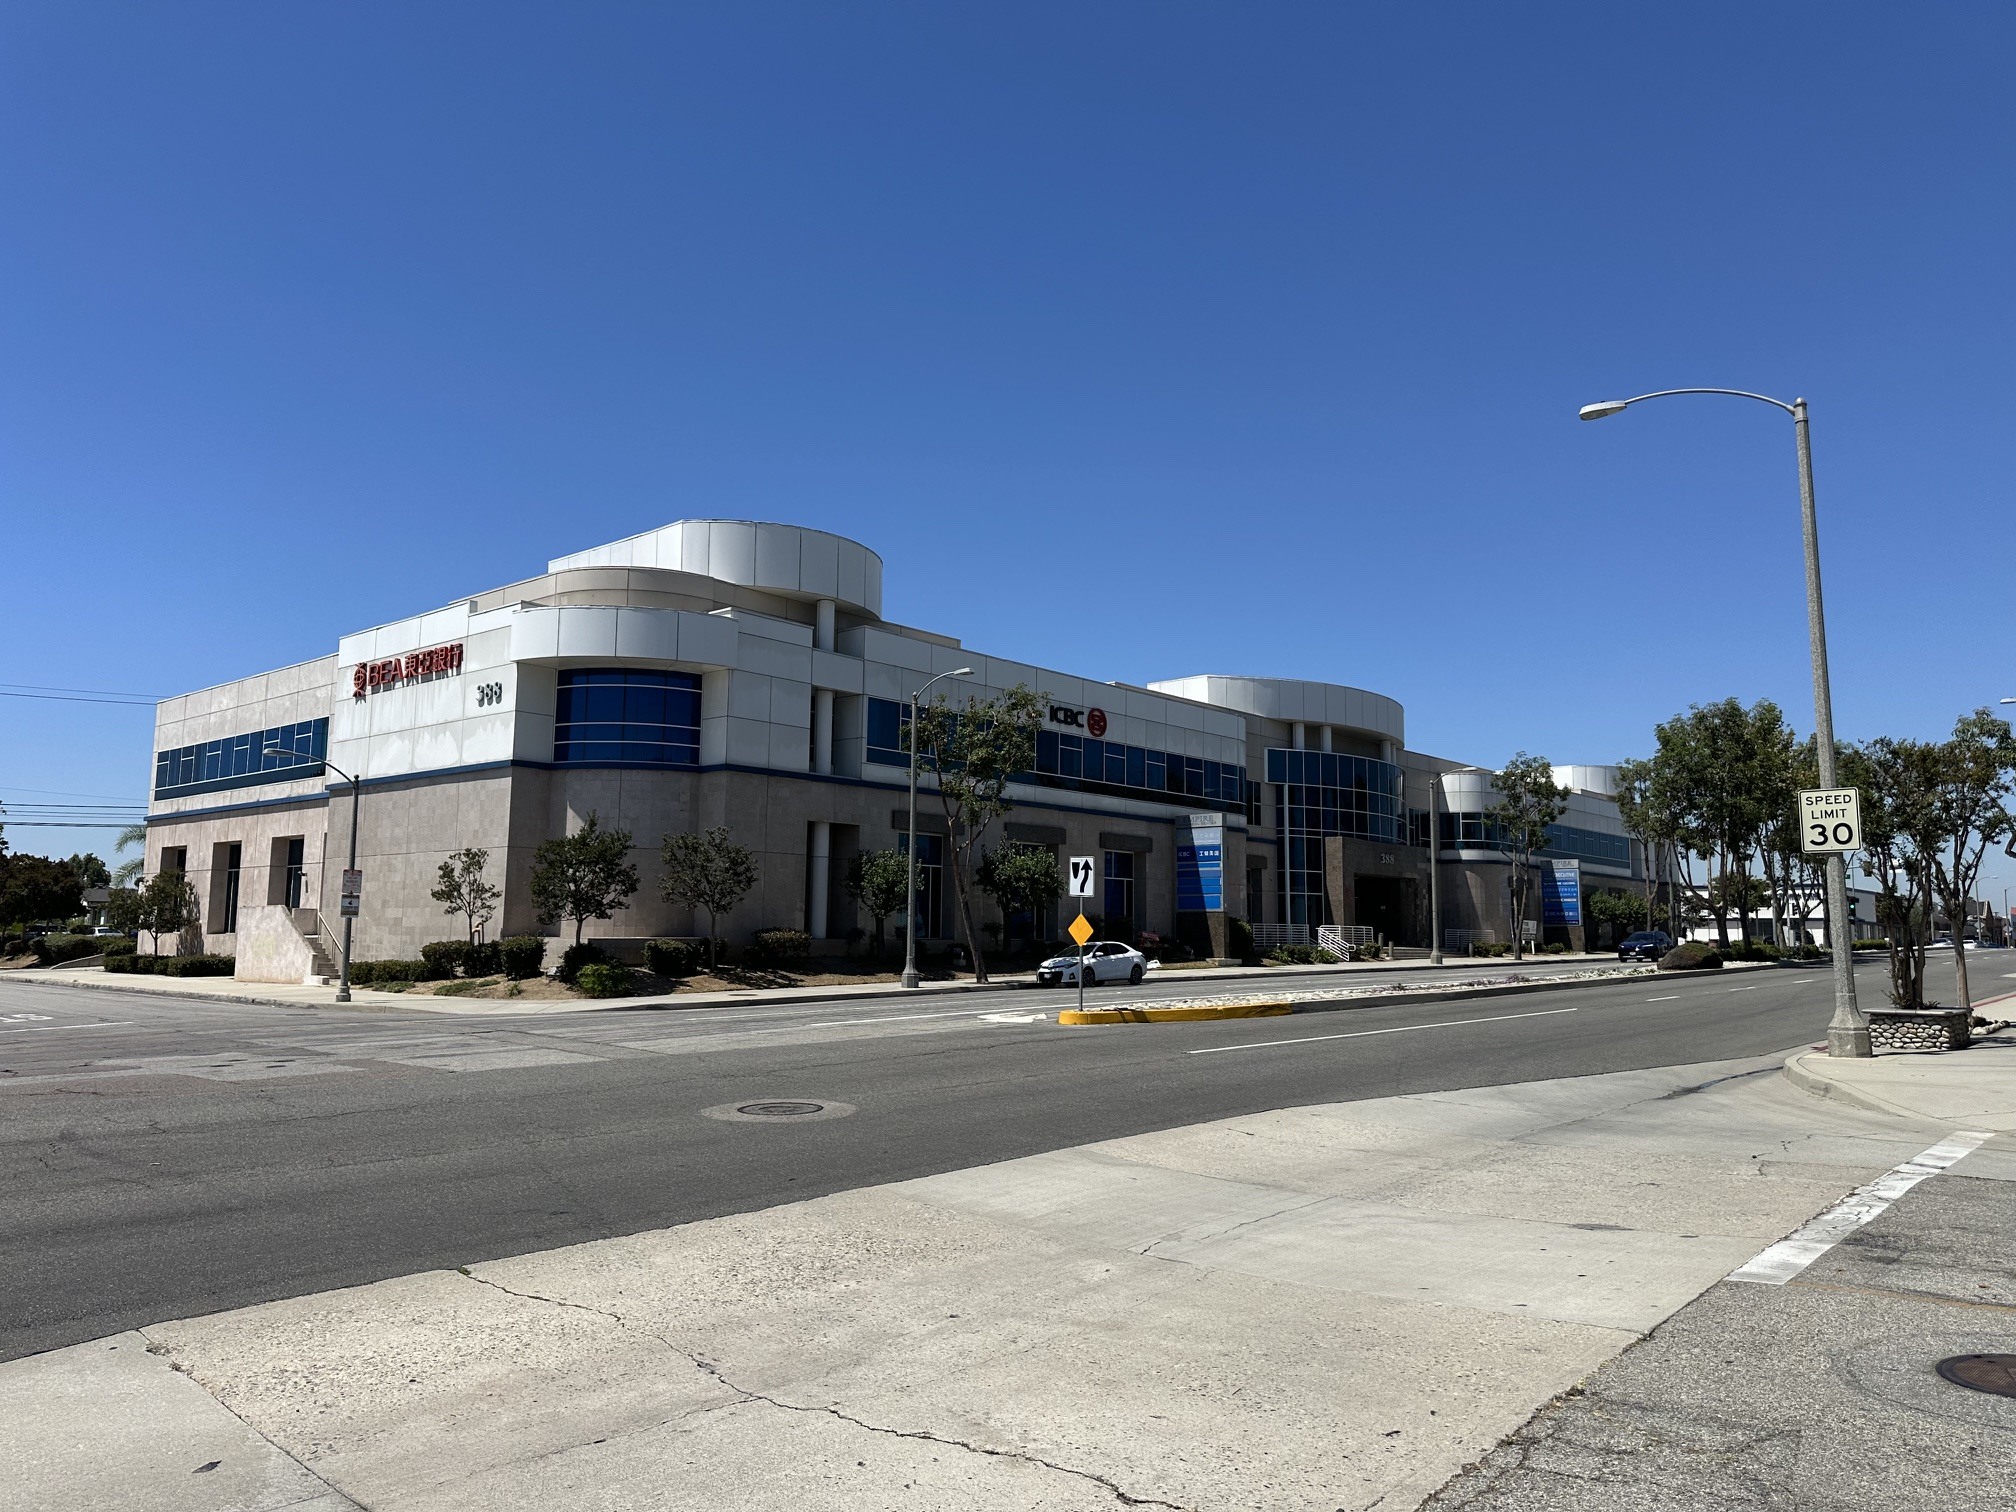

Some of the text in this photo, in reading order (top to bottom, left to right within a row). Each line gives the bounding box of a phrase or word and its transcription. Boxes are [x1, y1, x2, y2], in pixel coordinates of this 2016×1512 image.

[367, 643, 463, 687] BEA 東亞銀行
[476, 682, 501, 702] 388
[1050, 705, 1084, 728] ICBC
[1806, 794, 1852, 806] SPEED
[1811, 808, 1847, 819] LIMIT
[1809, 822, 1853, 846] 30
[1380, 853, 1395, 864] 388
